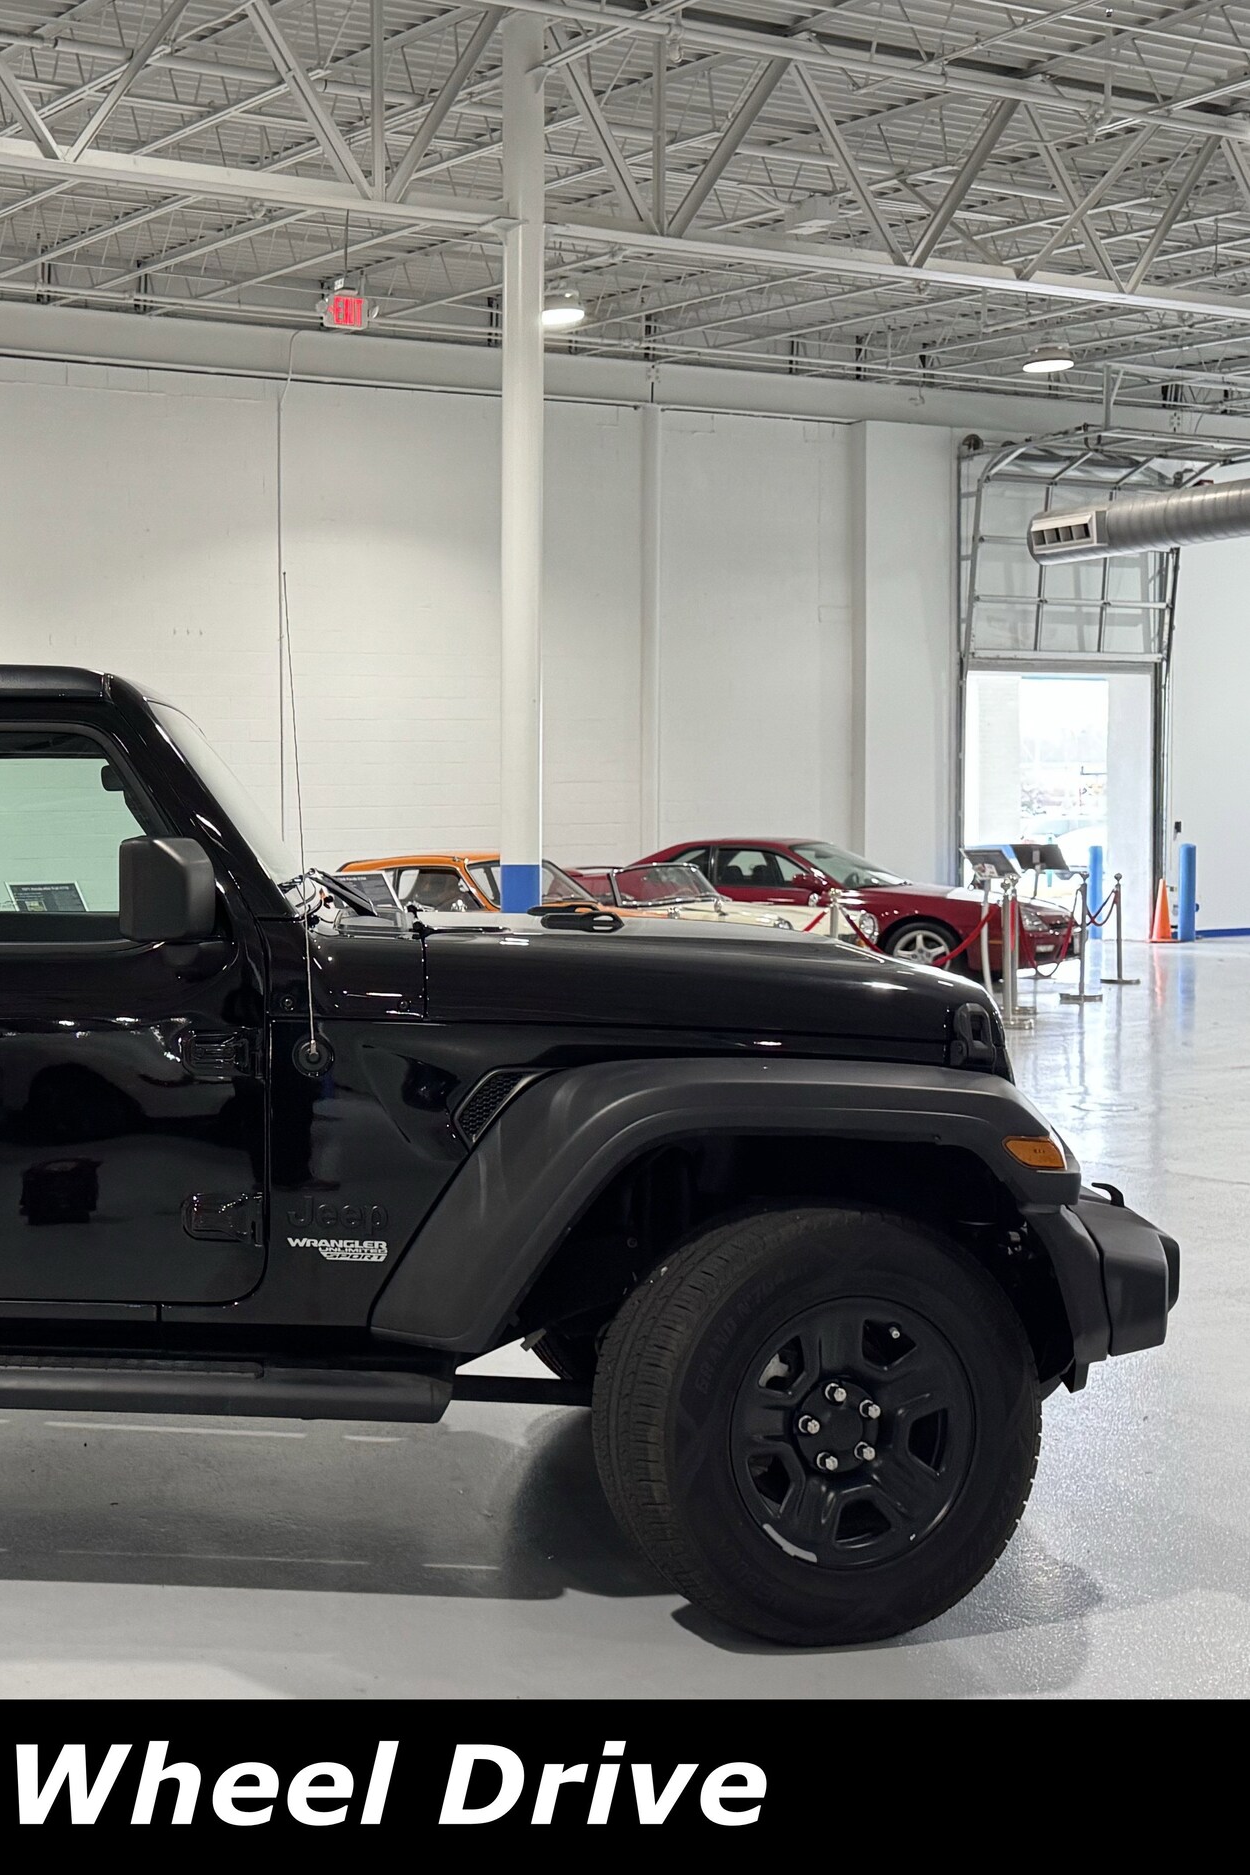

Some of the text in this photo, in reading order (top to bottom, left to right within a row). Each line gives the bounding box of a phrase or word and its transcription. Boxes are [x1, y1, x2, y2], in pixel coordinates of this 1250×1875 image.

[334, 295, 364, 327] EXIT
[287, 1195, 389, 1237] Jeep
[287, 1238, 387, 1249] WRANGLER
[318, 1246, 388, 1254] UNLIMITED
[325, 1252, 384, 1260] SPORT
